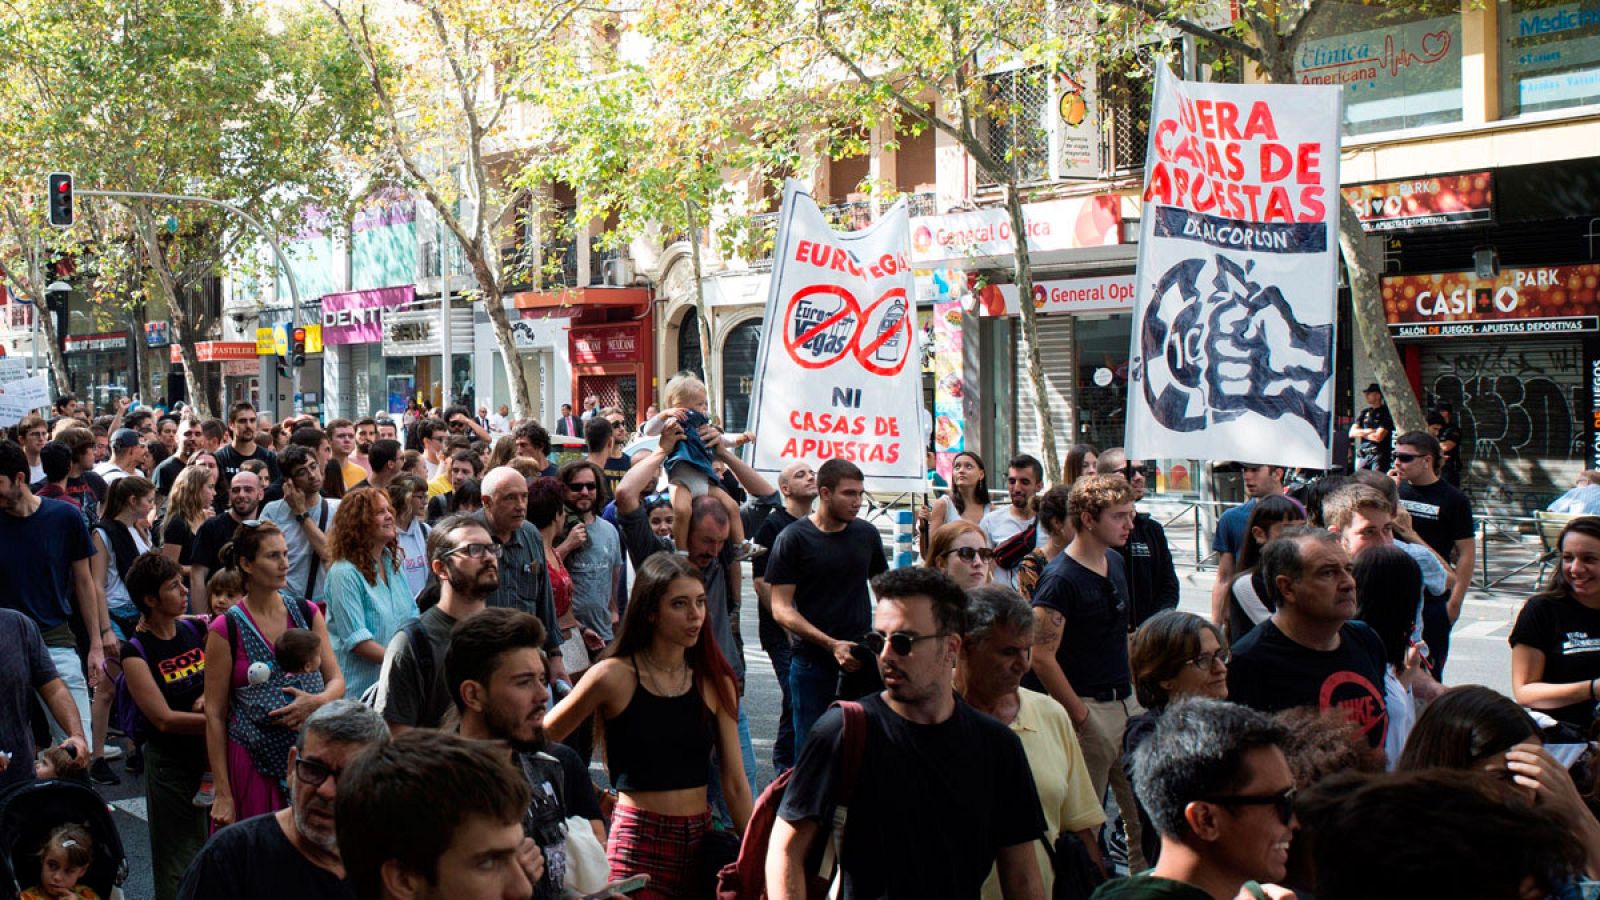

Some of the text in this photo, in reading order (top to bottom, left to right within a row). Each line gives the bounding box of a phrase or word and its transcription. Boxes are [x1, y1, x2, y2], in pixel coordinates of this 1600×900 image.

[1302, 67, 1377, 85] Americana
[1175, 91, 1279, 140] UERA
[1155, 119, 1321, 184] CASAS DE
[1143, 161, 1326, 224] APUESTAS
[1399, 180, 1430, 195] PARK
[936, 218, 1051, 247] General Oica
[1513, 268, 1560, 288] PARK
[1051, 282, 1135, 303] General Opt
[1399, 324, 1427, 336] SALÓN
[1428, 325, 1441, 335] DE
[1441, 323, 1475, 334] JUEGOS
[1481, 321, 1525, 333] APUESTAS
[1527, 319, 1583, 332] DEPORTIVAS
[831, 386, 862, 409] NI
[790, 410, 900, 437] CASAS DE
[780, 436, 900, 464] APUESTAS
[160, 649, 203, 673] SOY
[1337, 695, 1374, 724] NIKE
